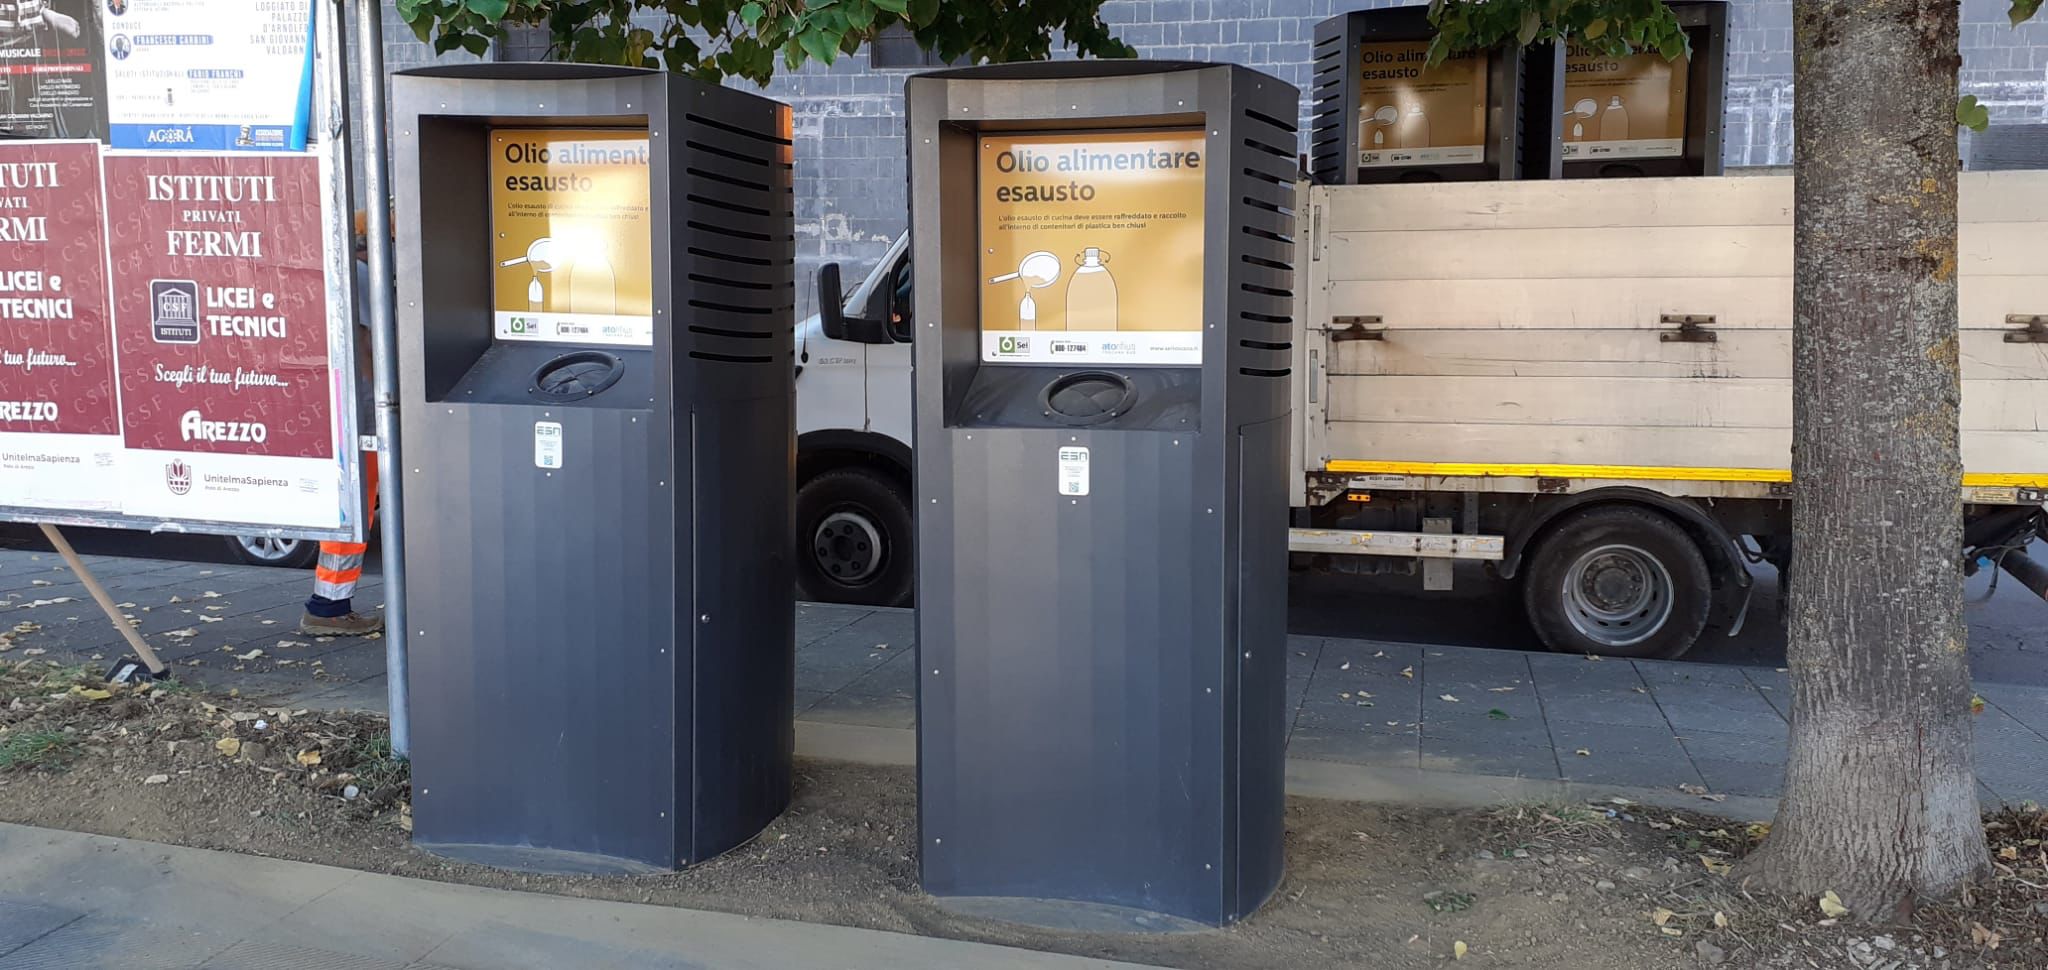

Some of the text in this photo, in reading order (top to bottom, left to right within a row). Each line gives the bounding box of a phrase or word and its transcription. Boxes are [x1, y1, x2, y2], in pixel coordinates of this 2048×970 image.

[255, 1, 296, 11] LOGGIATO
[250, 34, 307, 45] SAN GIOVANN
[0, 48, 41, 58] MUSICALE
[266, 45, 305, 56] VALDARN
[1363, 50, 1394, 64] Olio
[1362, 66, 1419, 80] esausto
[505, 142, 650, 165] Olio aliment
[996, 148, 1201, 173] Olio alimentare
[147, 175, 277, 203] ISTITUTI
[505, 172, 593, 192] esausto
[996, 181, 1096, 202] esausto
[182, 210, 241, 223] PRIVATI
[998, 214, 1016, 222] L'olio
[1113, 212, 1152, 220] raffreddato
[1158, 211, 1187, 219] raccolto
[1085, 222, 1111, 231] plastica
[165, 230, 263, 258] FERMI
[0, 270, 62, 292] LICEI e
[206, 287, 275, 309] LICEI e
[0, 298, 74, 319] TECNICI
[160, 327, 192, 337] ISTITUTI
[206, 315, 287, 338] TECNICI
[1016, 341, 1029, 349] Sei
[4, 349, 24, 366] tuo
[154, 363, 194, 389] Scegli
[196, 364, 208, 384] il
[209, 368, 232, 385] tuo
[2, 452, 81, 464] UnitelmaSapienza
[203, 473, 289, 488] UnitelmaSapienza
